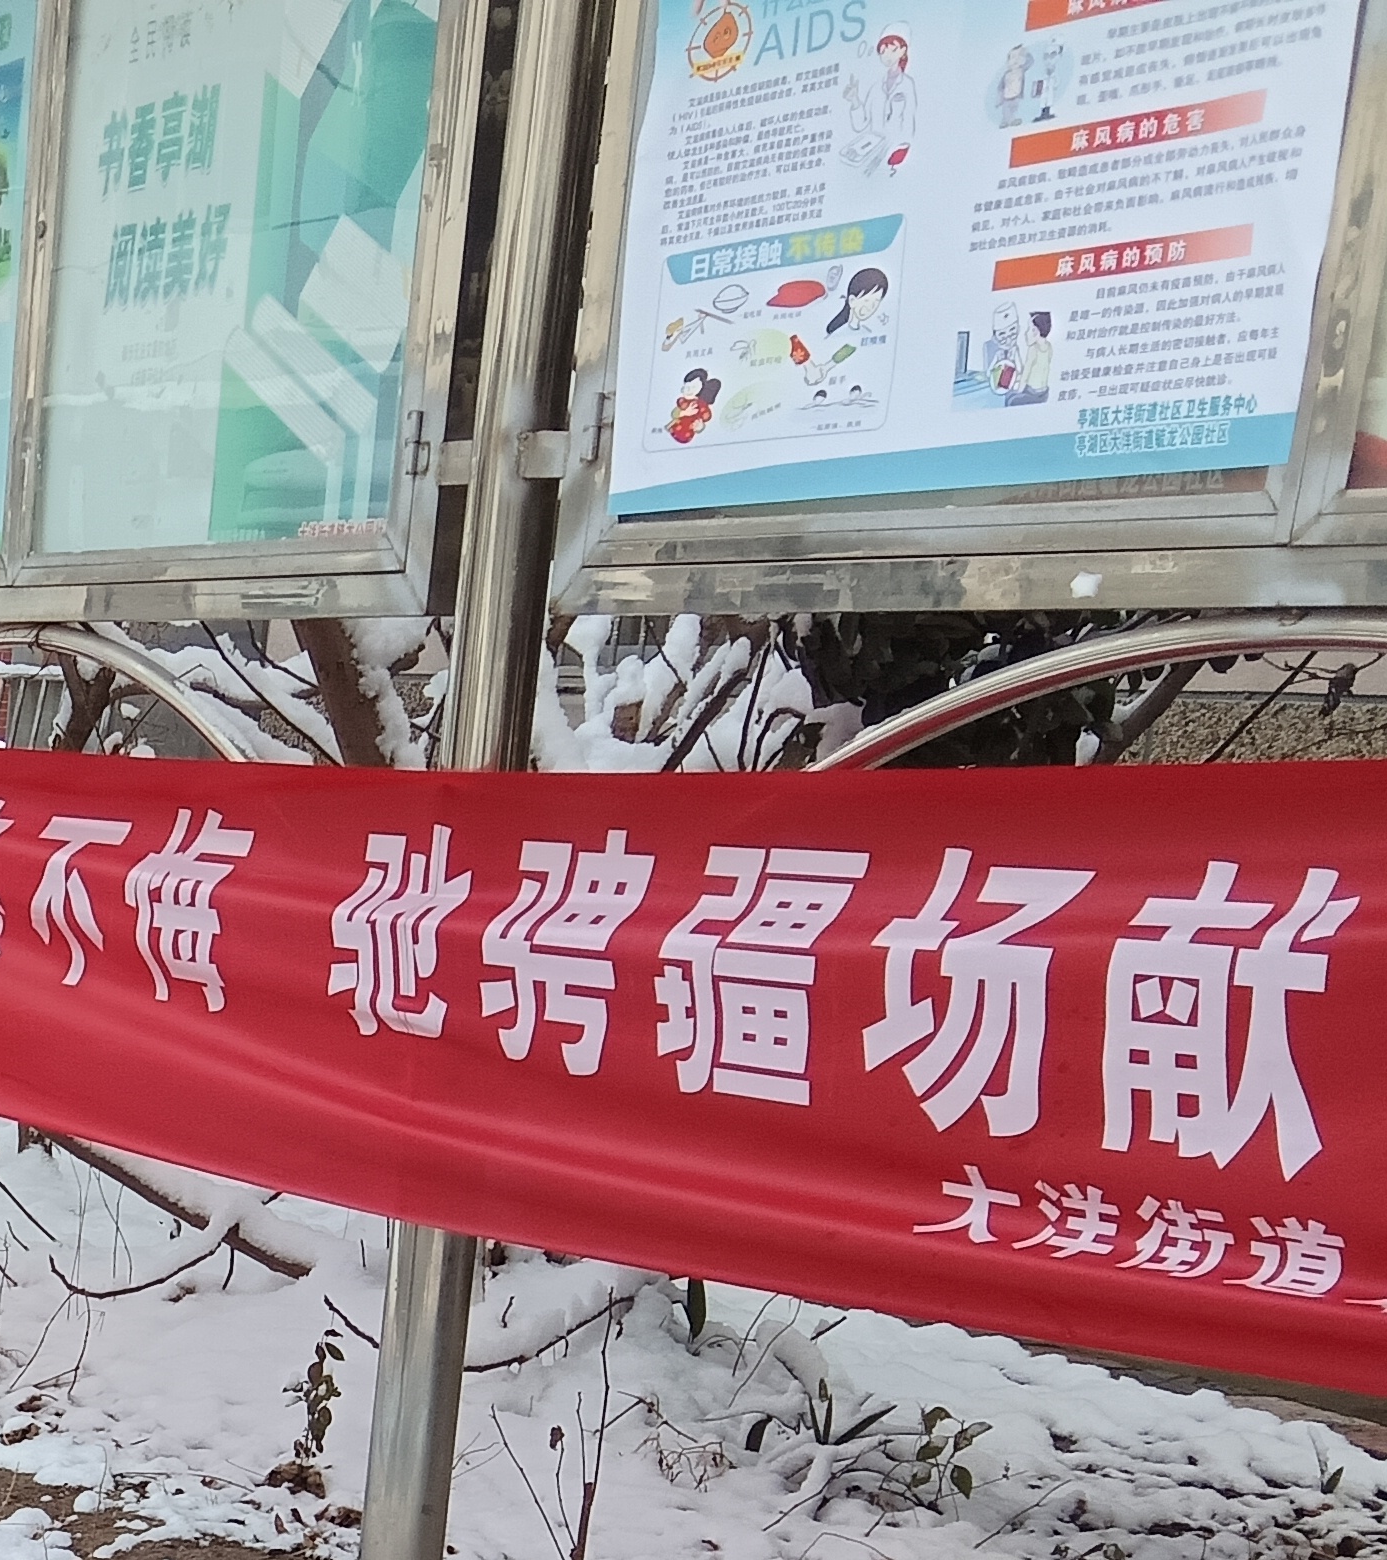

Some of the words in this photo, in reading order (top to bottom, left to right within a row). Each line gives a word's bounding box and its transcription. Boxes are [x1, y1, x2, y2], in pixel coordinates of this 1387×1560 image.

[753, 0, 866, 66] AIDS
[98, 82, 221, 202] 书香亭湖
[1069, 108, 1207, 152] 麻风病的危害
[690, 239, 783, 281] 日常接触
[1055, 239, 1188, 277] 麻风病的预防
[1077, 393, 1258, 428] 亭湖区大洋街道社区卫生服务中心
[1076, 421, 1229, 456] 亭湖区大洋街道毓龙公园社区
[327, 823, 1361, 1180] 驰骋疆场献
[912, 1163, 1387, 1314] 大洋街道
